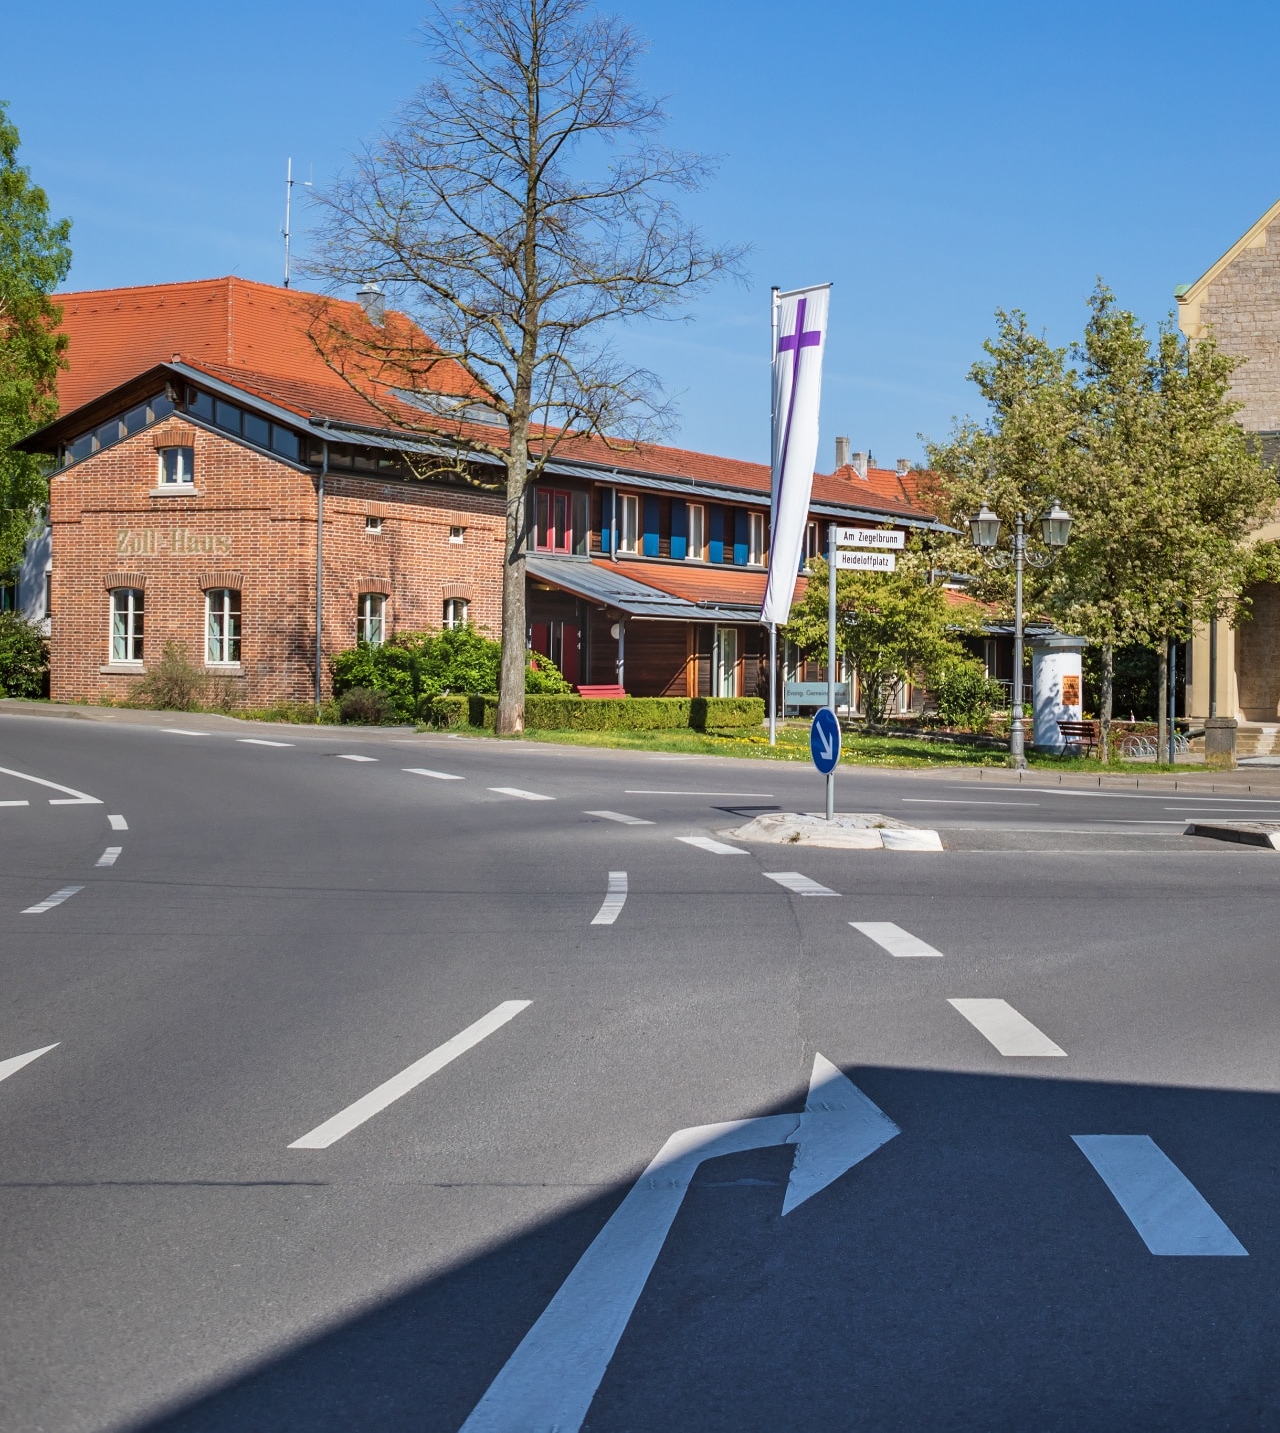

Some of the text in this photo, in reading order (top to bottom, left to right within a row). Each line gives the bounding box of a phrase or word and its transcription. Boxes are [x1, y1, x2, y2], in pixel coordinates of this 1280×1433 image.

[843, 531, 898, 545] Am Ziegelbrunn
[842, 553, 889, 567] Heideloffplatz
